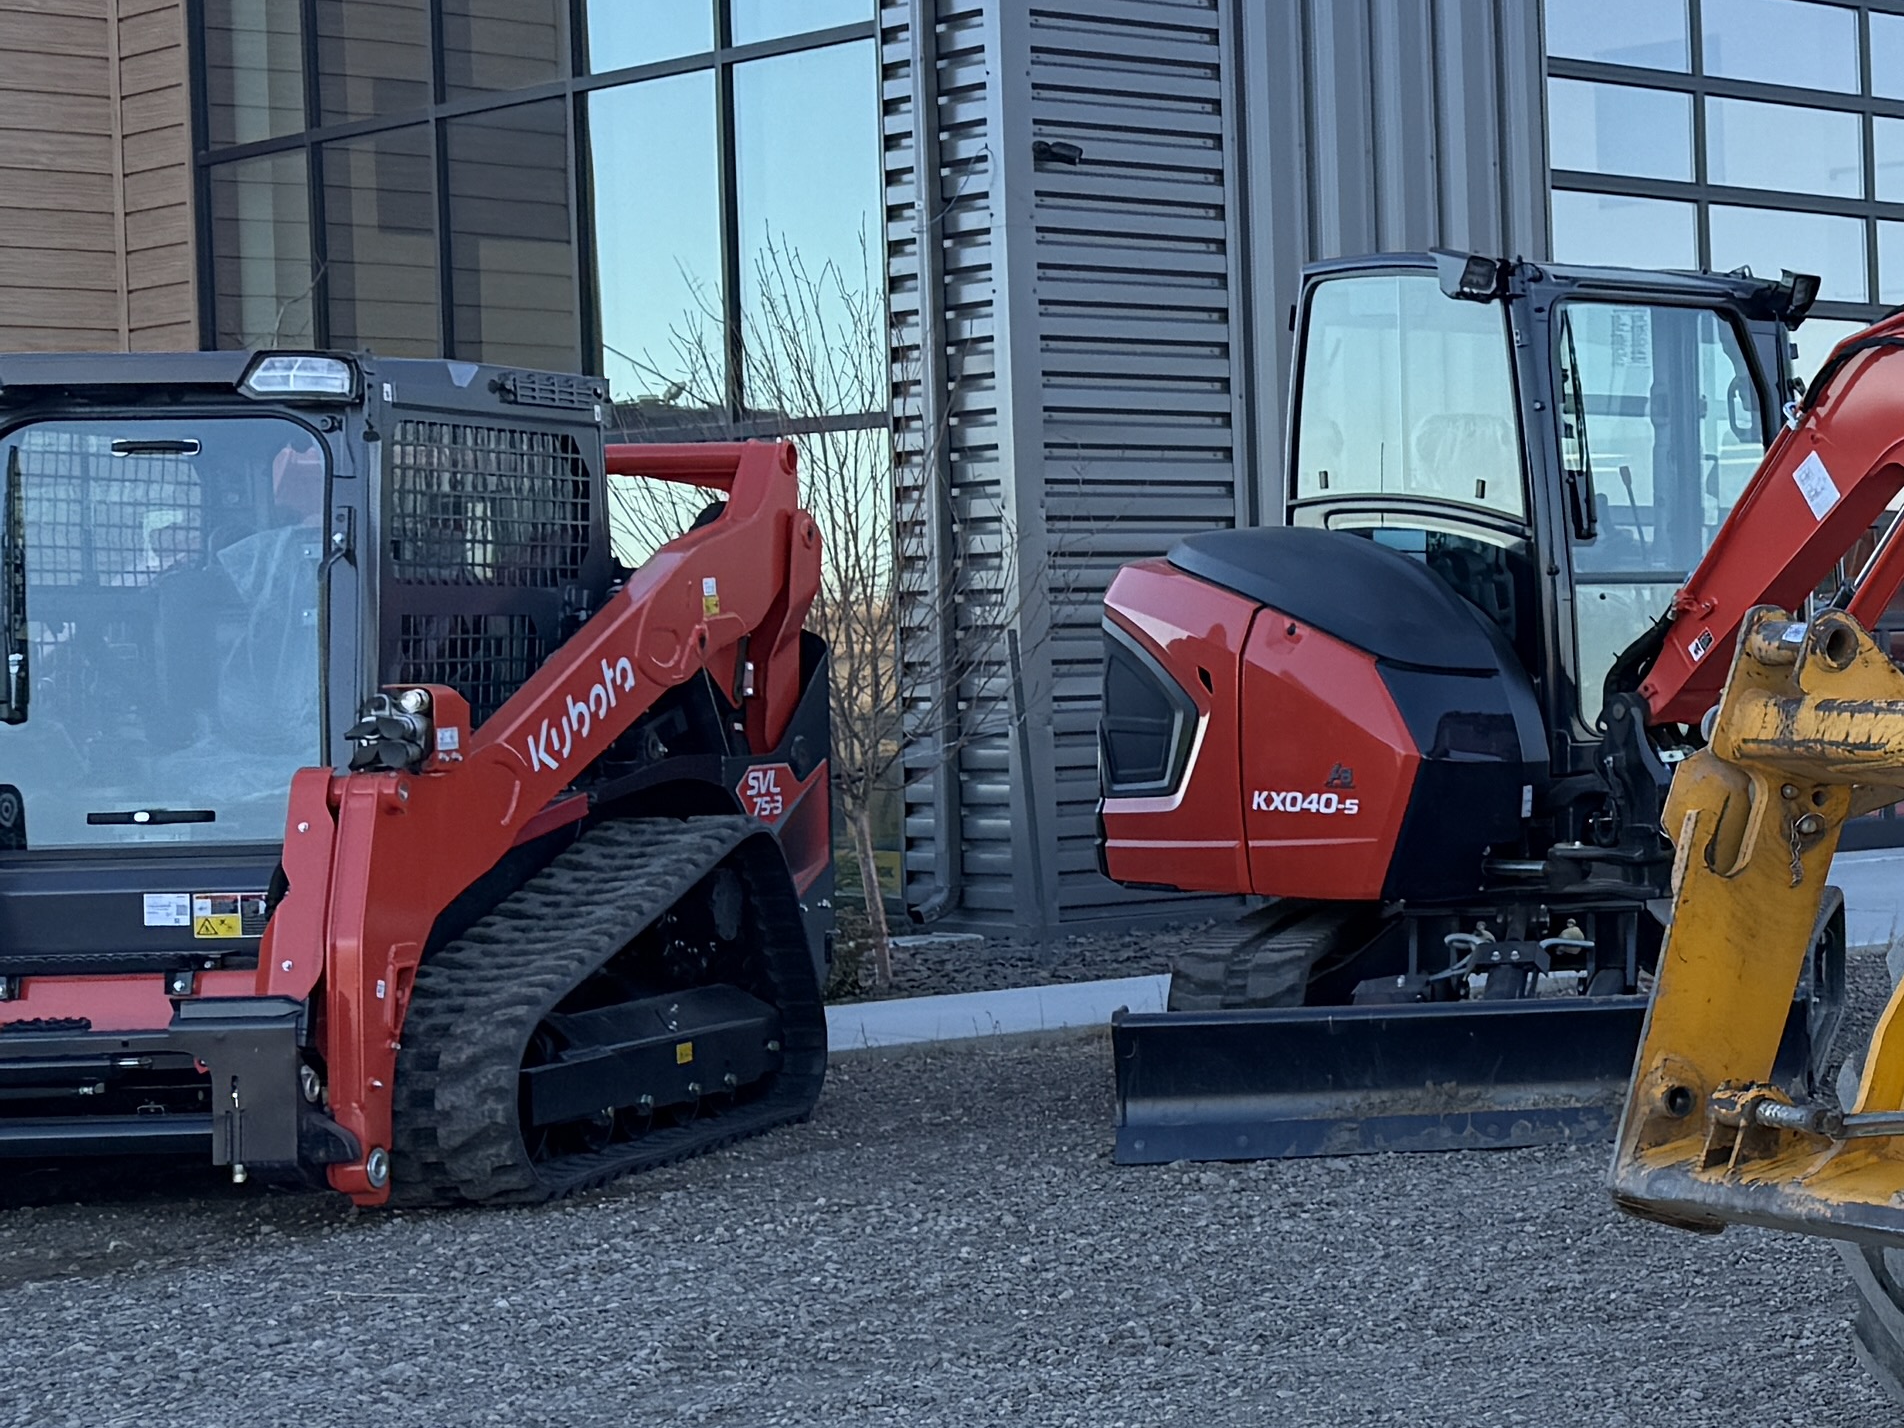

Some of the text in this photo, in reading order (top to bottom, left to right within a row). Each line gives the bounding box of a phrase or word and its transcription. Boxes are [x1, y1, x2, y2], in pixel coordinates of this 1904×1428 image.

[527, 656, 636, 772] Kubota
[747, 770, 781, 796] SVL
[753, 795, 783, 817] 75-3
[1252, 790, 1359, 815] KX040-5
